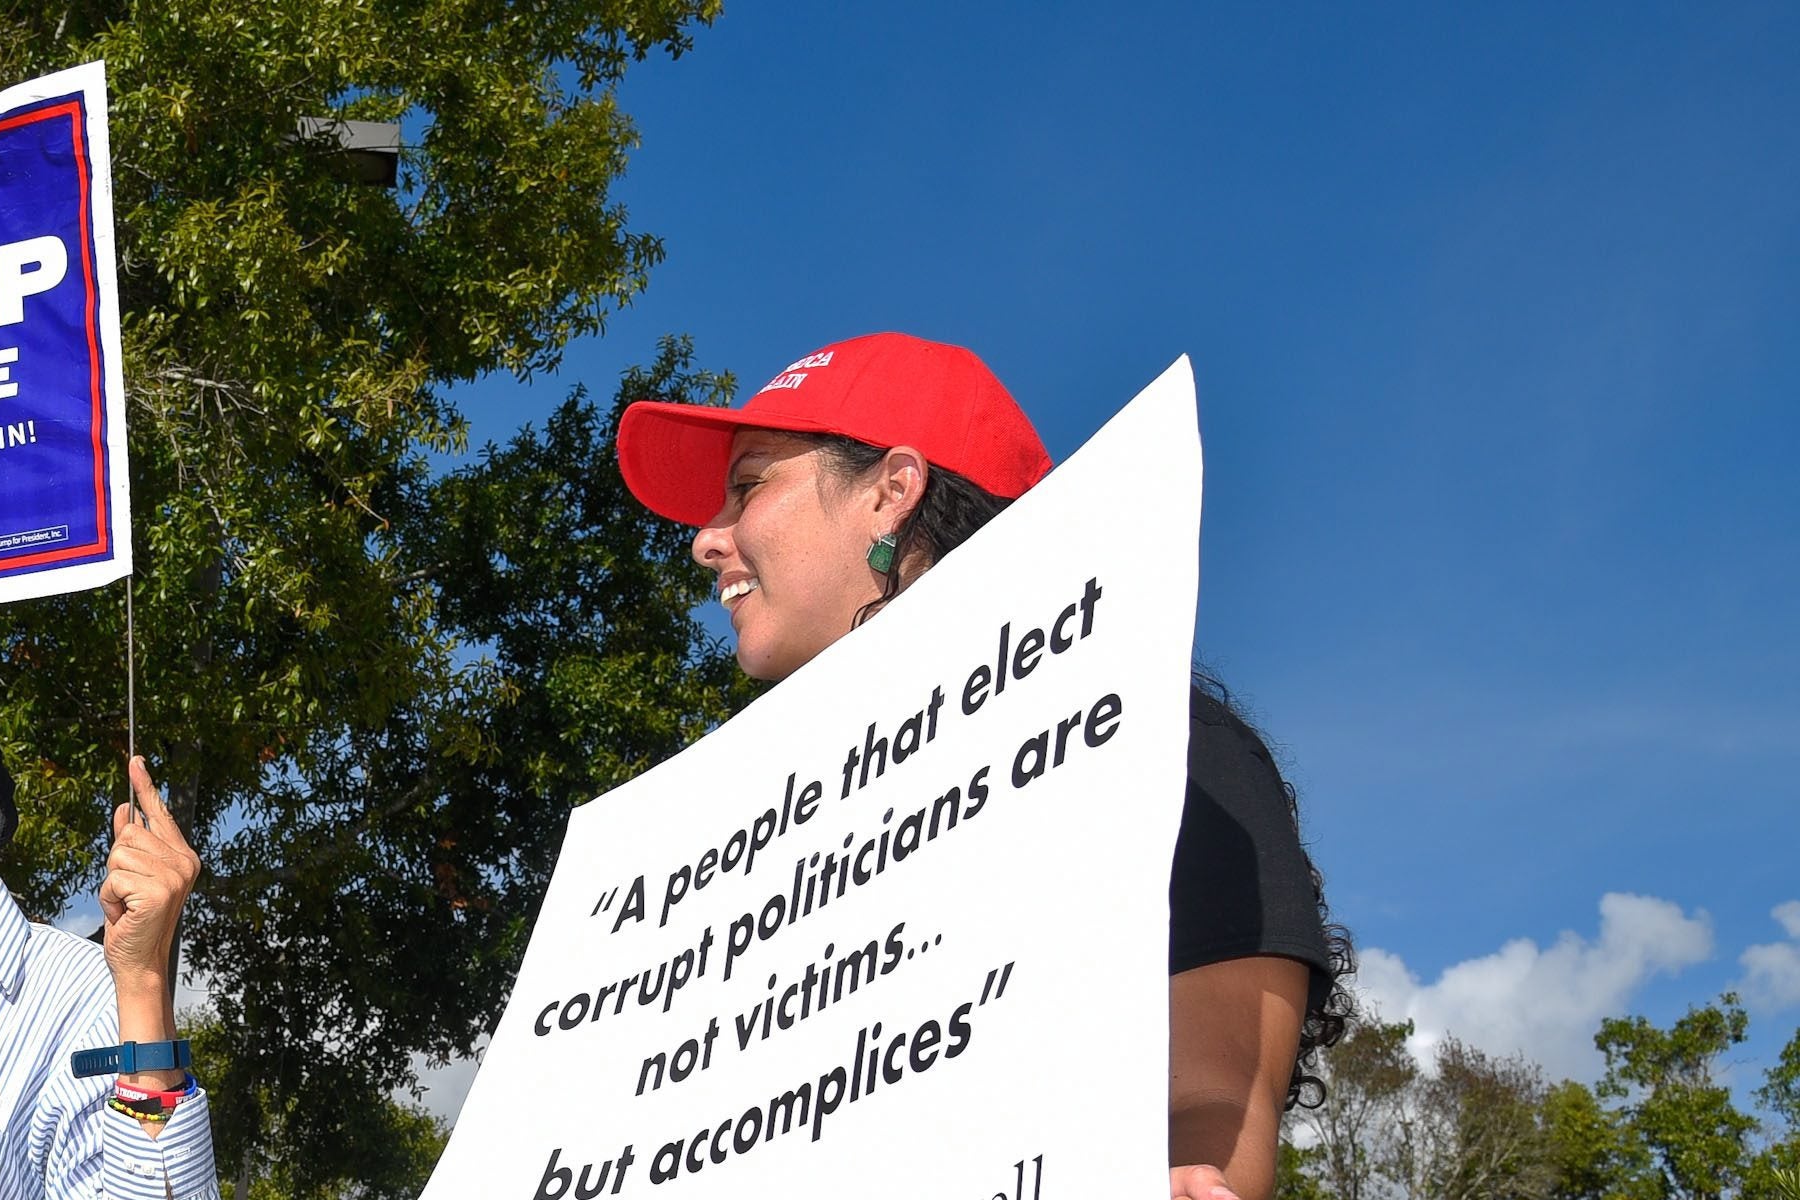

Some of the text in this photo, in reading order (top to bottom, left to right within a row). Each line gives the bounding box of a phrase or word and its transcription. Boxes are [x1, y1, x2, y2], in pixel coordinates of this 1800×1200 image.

[12, 536, 21, 545] for
[660, 773, 822, 925] people
[840, 685, 945, 799] that
[961, 576, 1103, 715] elect
[534, 693, 1122, 1036] corrupt politicians are
[635, 922, 942, 1096] not victims...
[649, 961, 1015, 1185] accomplices"
